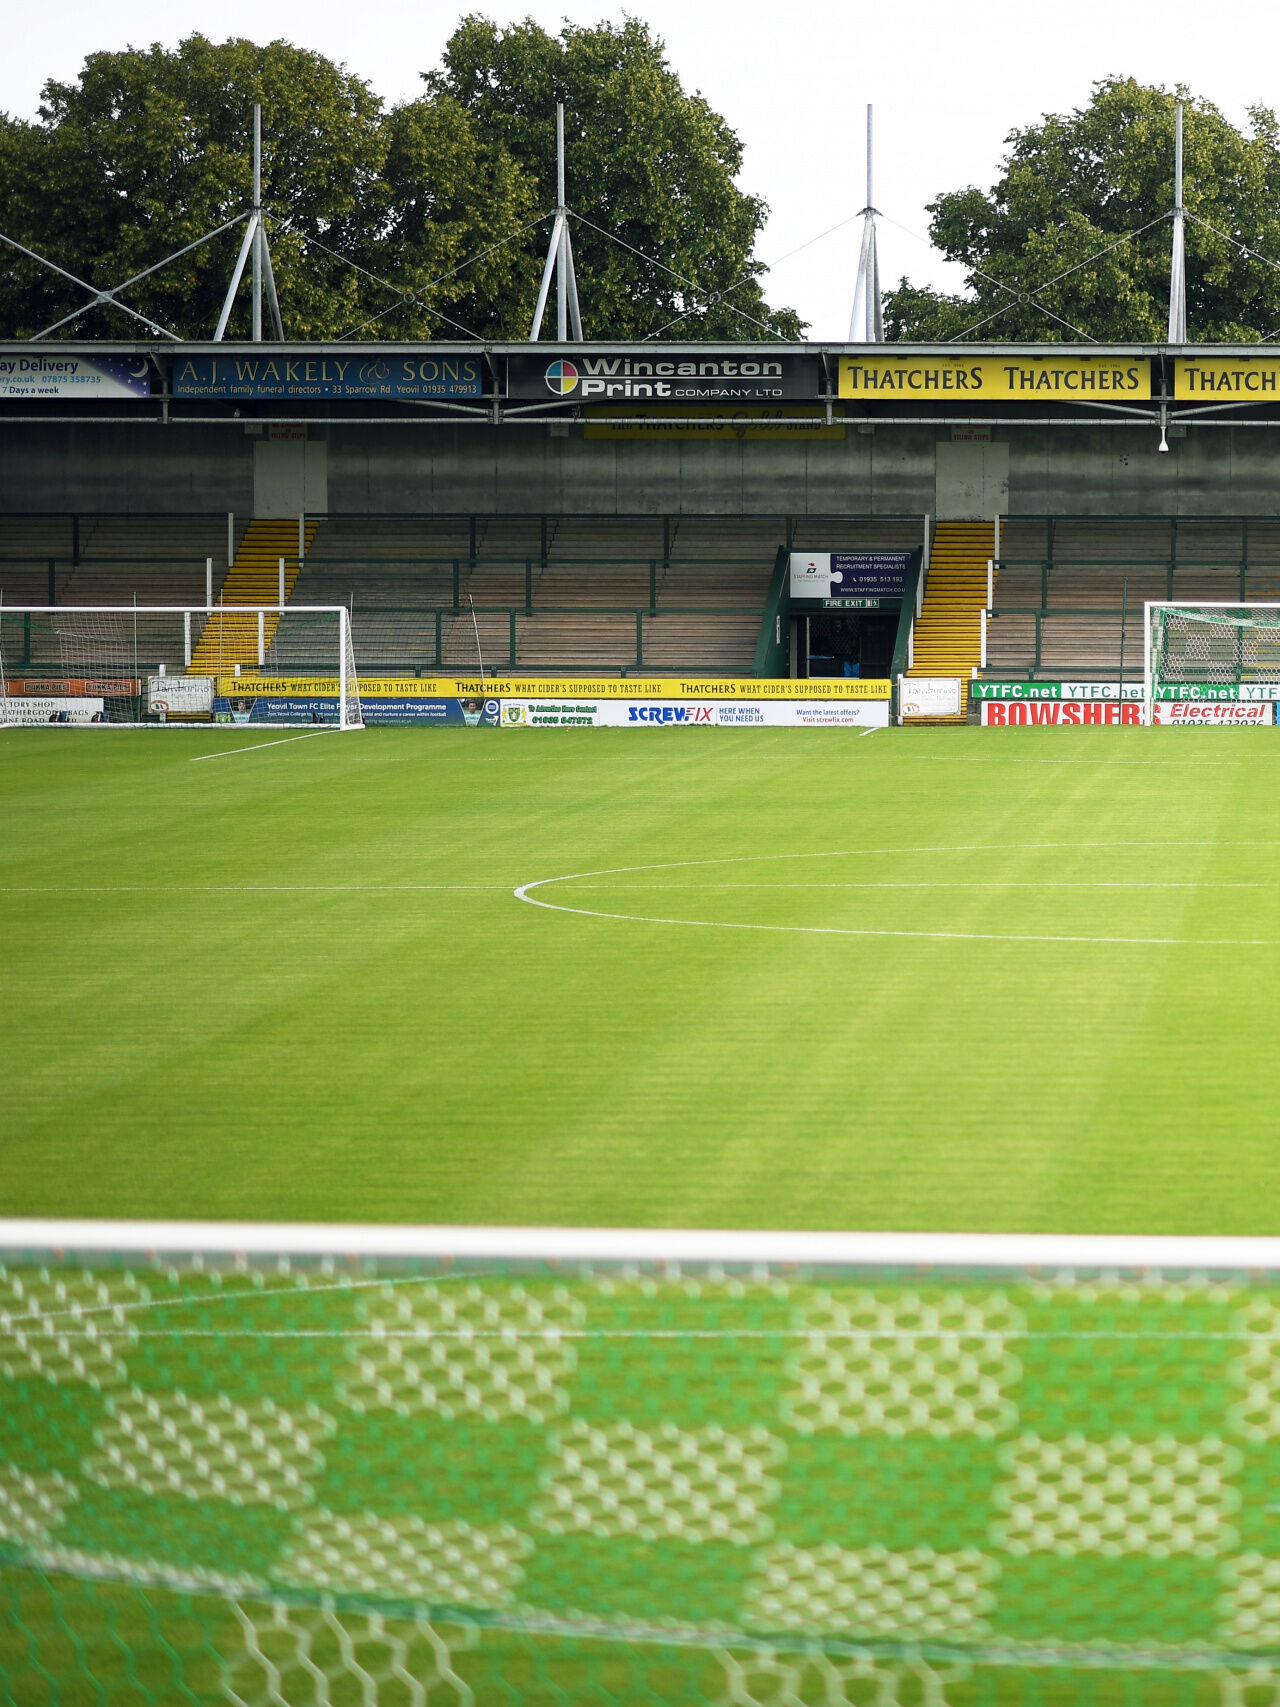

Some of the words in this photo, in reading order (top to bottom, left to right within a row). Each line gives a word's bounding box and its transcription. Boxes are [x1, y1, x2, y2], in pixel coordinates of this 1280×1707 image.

[19, 359, 78, 374] Delivery
[179, 361, 226, 385] A.J.
[235, 361, 350, 381] WAKELY
[402, 361, 477, 381] SONS
[582, 358, 782, 375] Wincanton
[0, 375, 35, 384] ry.co.uk
[847, 366, 983, 389] THATCHERS
[1004, 366, 1139, 390] THATCHERS
[9, 386, 29, 395] Days
[38, 386, 59, 394] week
[177, 385, 226, 395] Independent
[230, 385, 254, 395] family
[257, 385, 284, 394] funeral
[288, 385, 321, 394] directors
[332, 385, 342, 394] 33
[345, 385, 376, 395] Sparrow
[380, 385, 392, 394] Rd.
[396, 385, 419, 394] Yeovil
[422, 385, 446, 394] 01935
[449, 385, 477, 394] 479913
[581, 379, 672, 397] Print
[232, 681, 287, 692] THATCHERS
[290, 683, 311, 692] WHAT
[384, 683, 393, 692] TO
[395, 683, 418, 692] TASTE
[420, 683, 437, 692] LIKE
[455, 682, 511, 693] THATCHERS
[515, 684, 536, 693] WHAT
[569, 684, 606, 693] SUPPOSED
[608, 684, 617, 693] TO
[620, 684, 642, 693] TASTE
[645, 684, 662, 693] LIKE
[680, 683, 736, 693] THATCHERS
[739, 685, 761, 693] WHAT
[794, 685, 831, 694] SUPPOSED
[834, 685, 843, 694] TO
[846, 685, 868, 694] TASTE
[871, 685, 887, 694] LIKE
[979, 685, 1057, 698] YTFC.net
[1069, 686, 1145, 698] YTFC.net
[1156, 686, 1235, 699] YTFC.net
[628, 707, 714, 724] SCREWFIX
[719, 707, 736, 715] HERE
[737, 707, 760, 715] WHEN
[1170, 703, 1266, 718] Electrical
